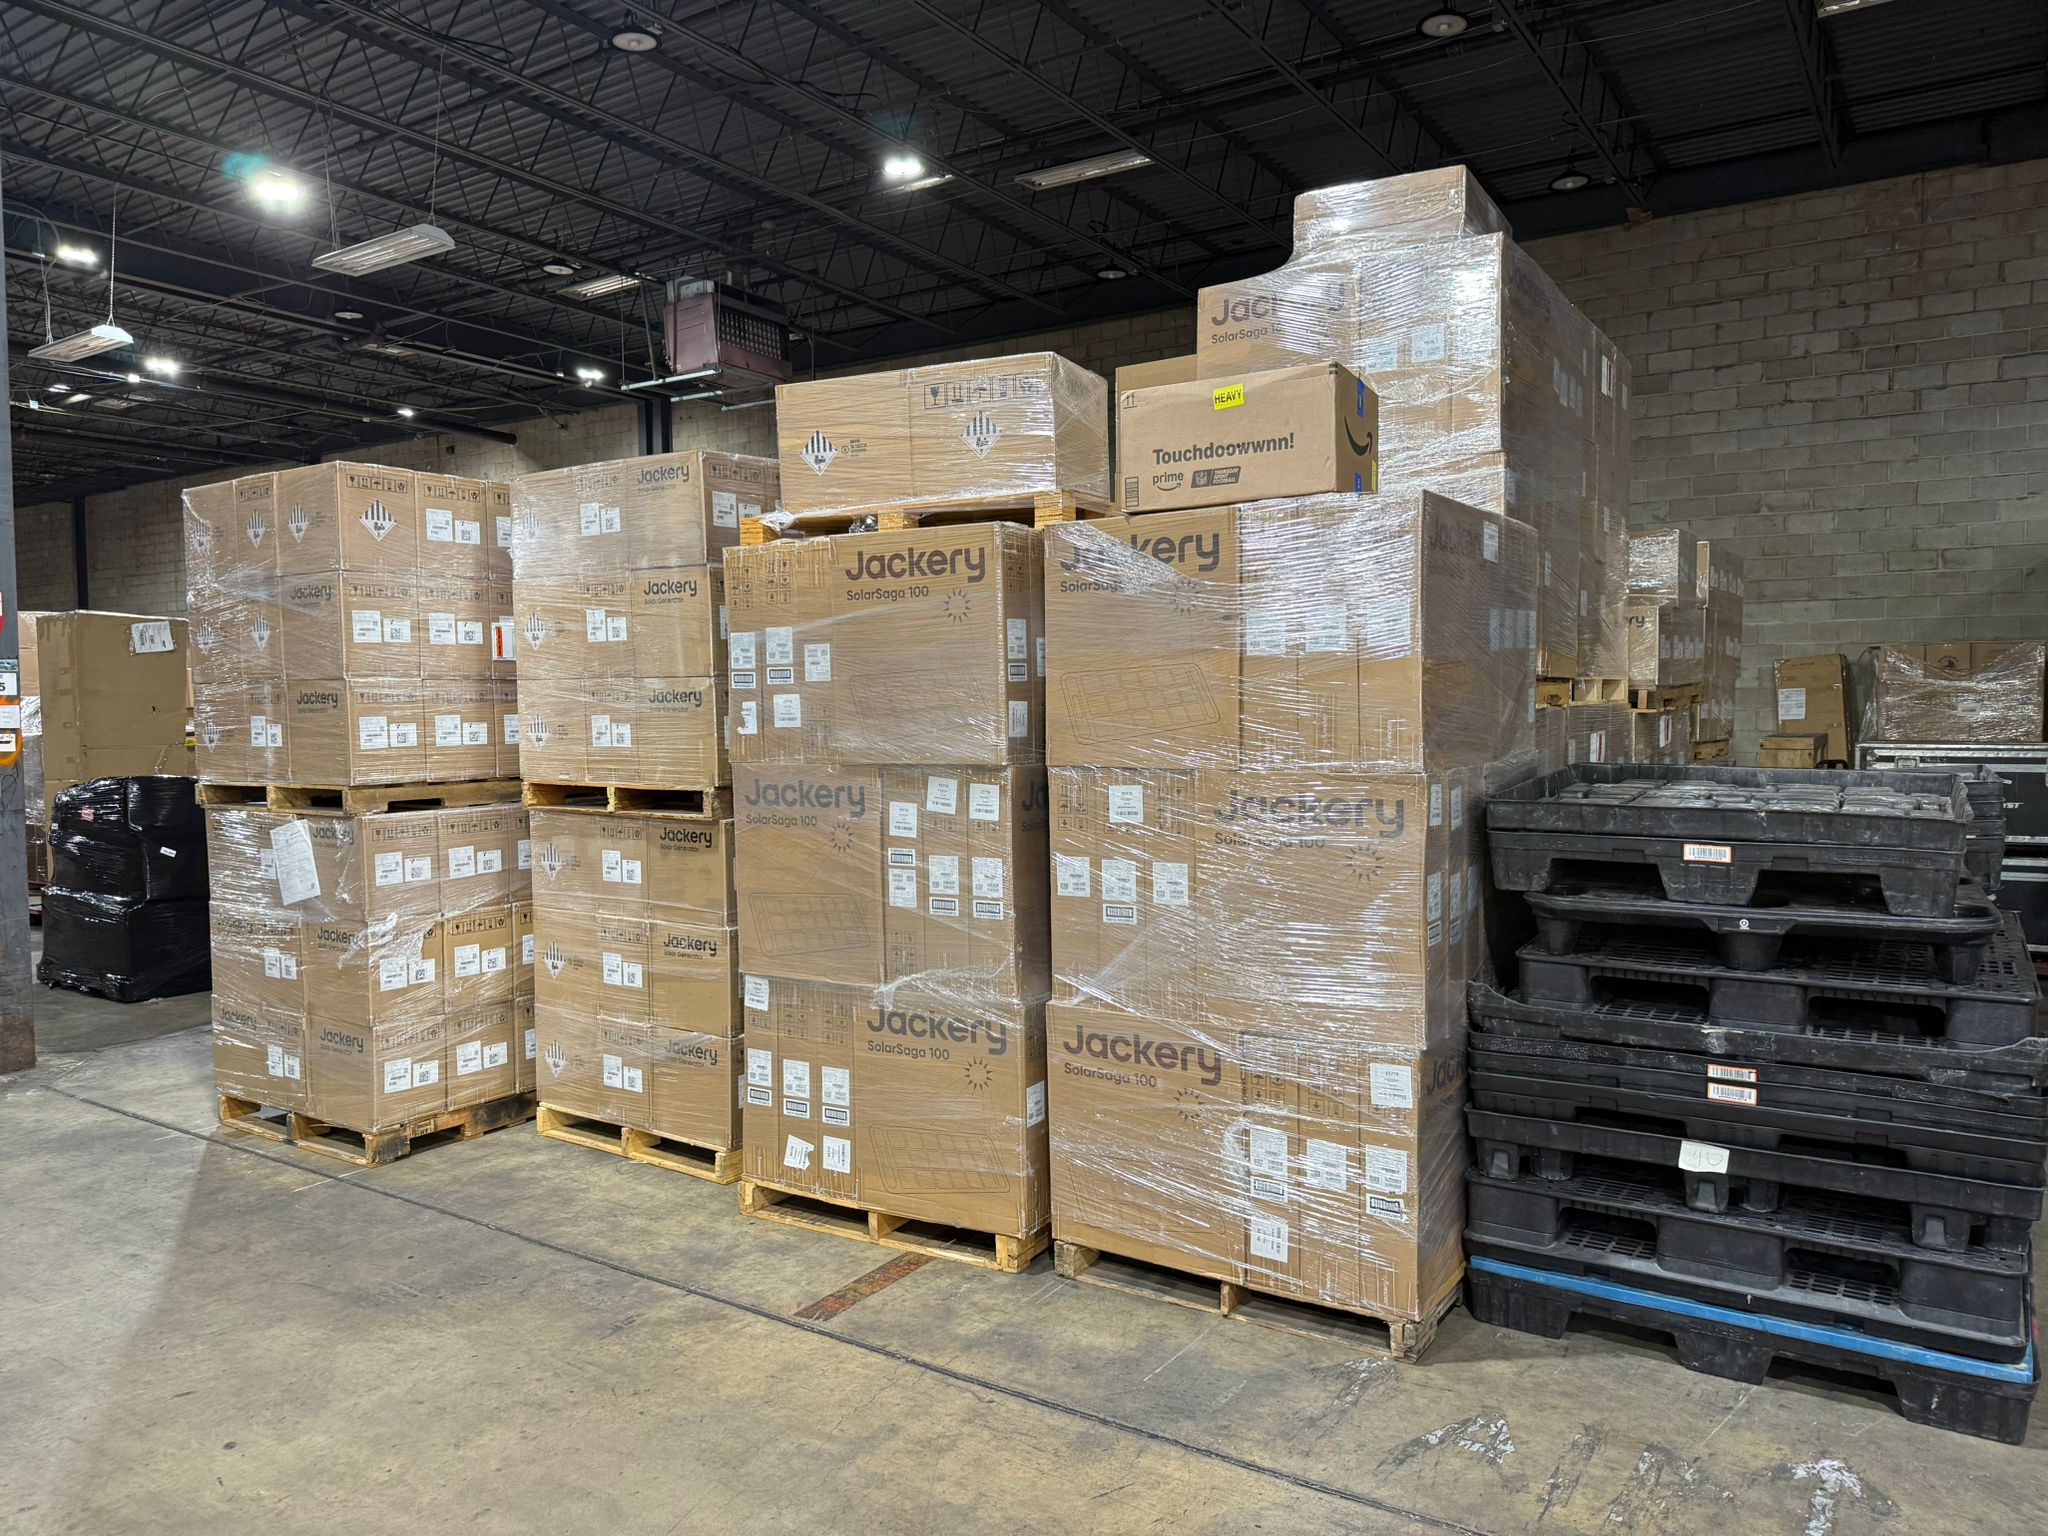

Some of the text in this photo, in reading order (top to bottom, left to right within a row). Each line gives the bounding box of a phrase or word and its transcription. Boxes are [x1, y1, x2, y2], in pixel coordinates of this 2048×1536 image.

[1211, 326, 1267, 344] SolarSaga
[1214, 389, 1242, 404] HEAVY
[1152, 432, 1294, 465] Touchdoowwnn!
[637, 464, 690, 483] Jackery
[1153, 472, 1184, 486] prime
[1060, 533, 1220, 572] Jkery
[844, 546, 985, 583] Jackery
[291, 584, 332, 600] Jackery
[643, 579, 698, 597] Jackery
[846, 586, 929, 601] SolarSaga 100
[297, 690, 338, 709] Jackery
[649, 689, 702, 707] Jackery
[745, 779, 866, 818] Jackery
[746, 814, 818, 828] SolarSaga 100
[1213, 789, 1405, 838] Jackery
[660, 827, 712, 849] Jackery
[663, 933, 717, 957] Jackery
[319, 1027, 364, 1052] Jackery
[866, 1005, 1007, 1055] Jackery
[664, 1039, 718, 1066] Jackery
[867, 1040, 949, 1060] SolarSaga 100
[1062, 1024, 1222, 1085] Jackery
[1064, 1062, 1157, 1088] SolarSaga 100
